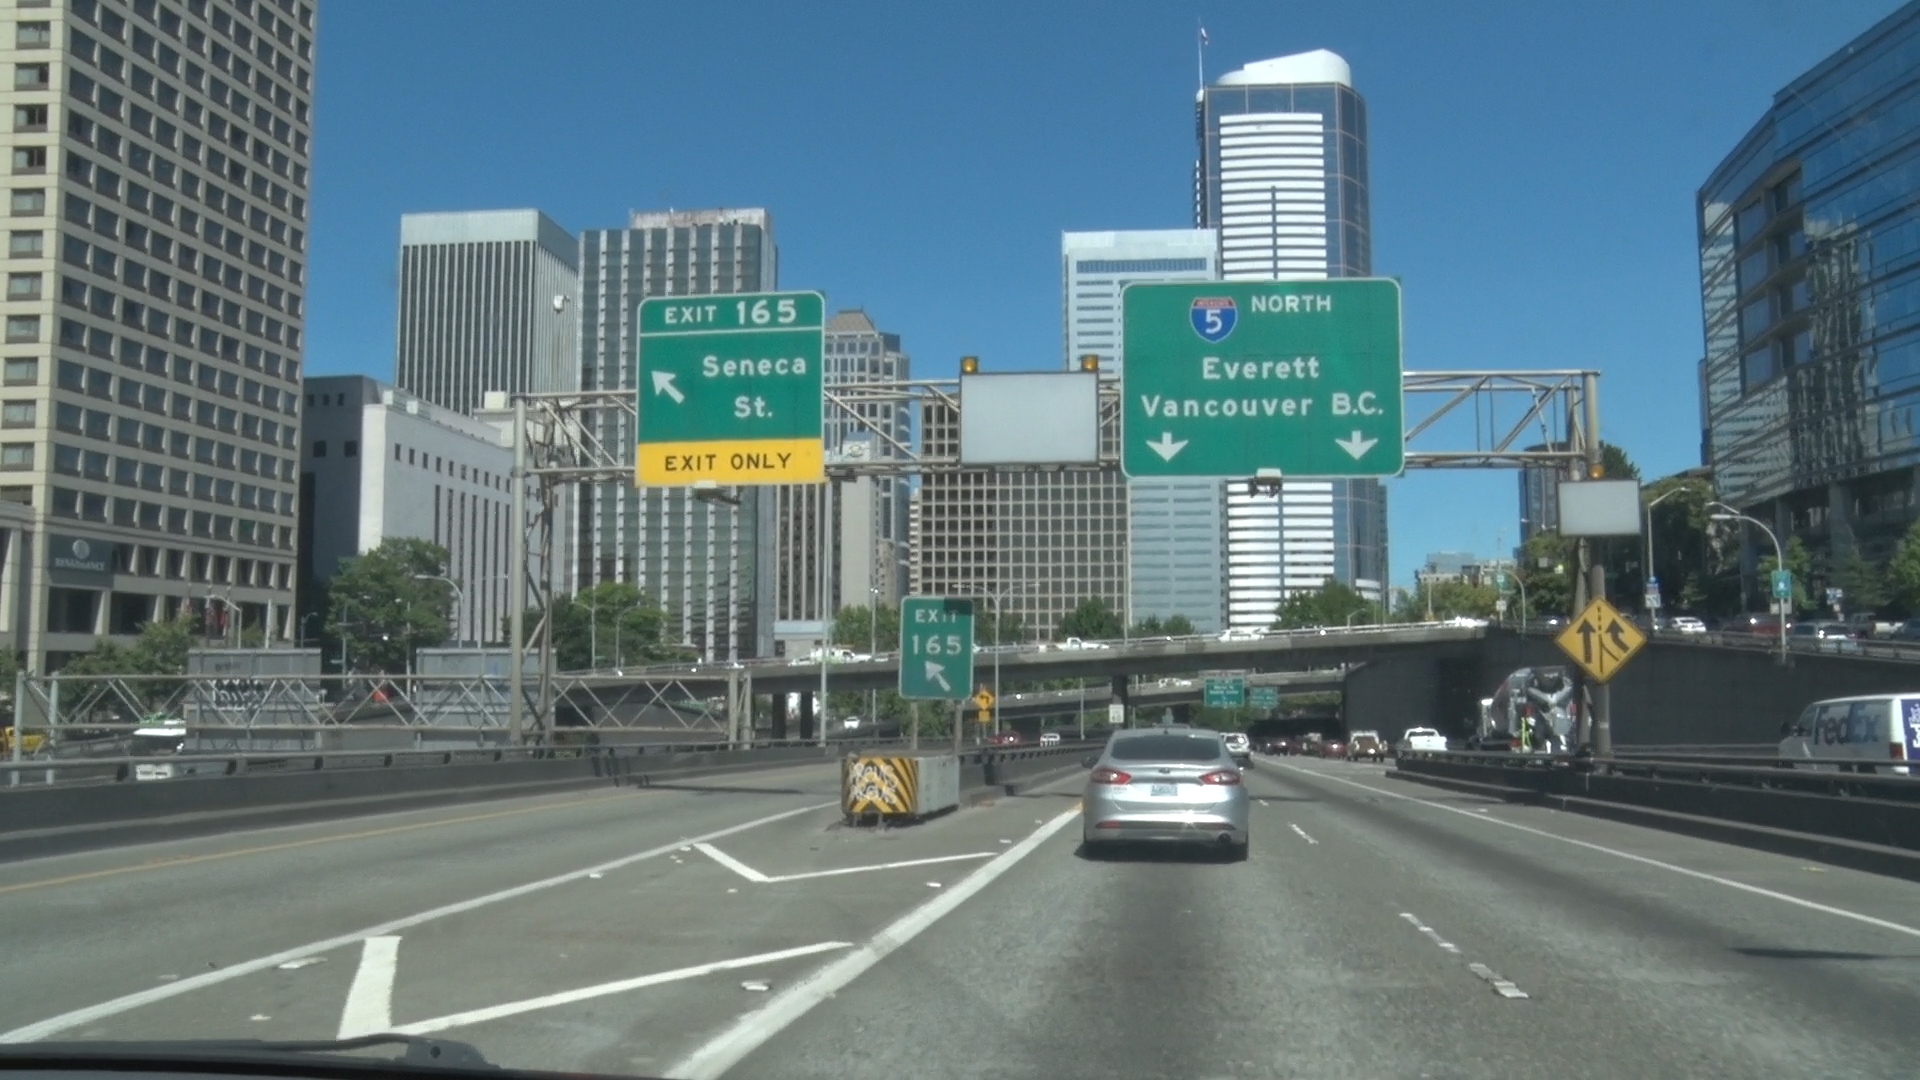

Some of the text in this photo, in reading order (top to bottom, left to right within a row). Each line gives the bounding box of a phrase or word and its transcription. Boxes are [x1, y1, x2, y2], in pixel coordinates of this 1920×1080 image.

[664, 299, 797, 325] EXIT 165
[1251, 294, 1332, 313] NORTH
[1205, 309, 1223, 334] 5
[702, 354, 807, 378] Seneca
[1202, 356, 1319, 380] Everett
[734, 395, 773, 419] St.
[1141, 391, 1384, 418] Vancouver B.C.
[664, 452, 792, 472] EXIT ONLY
[912, 634, 961, 656] 165
[1814, 703, 1880, 746] FedEx
